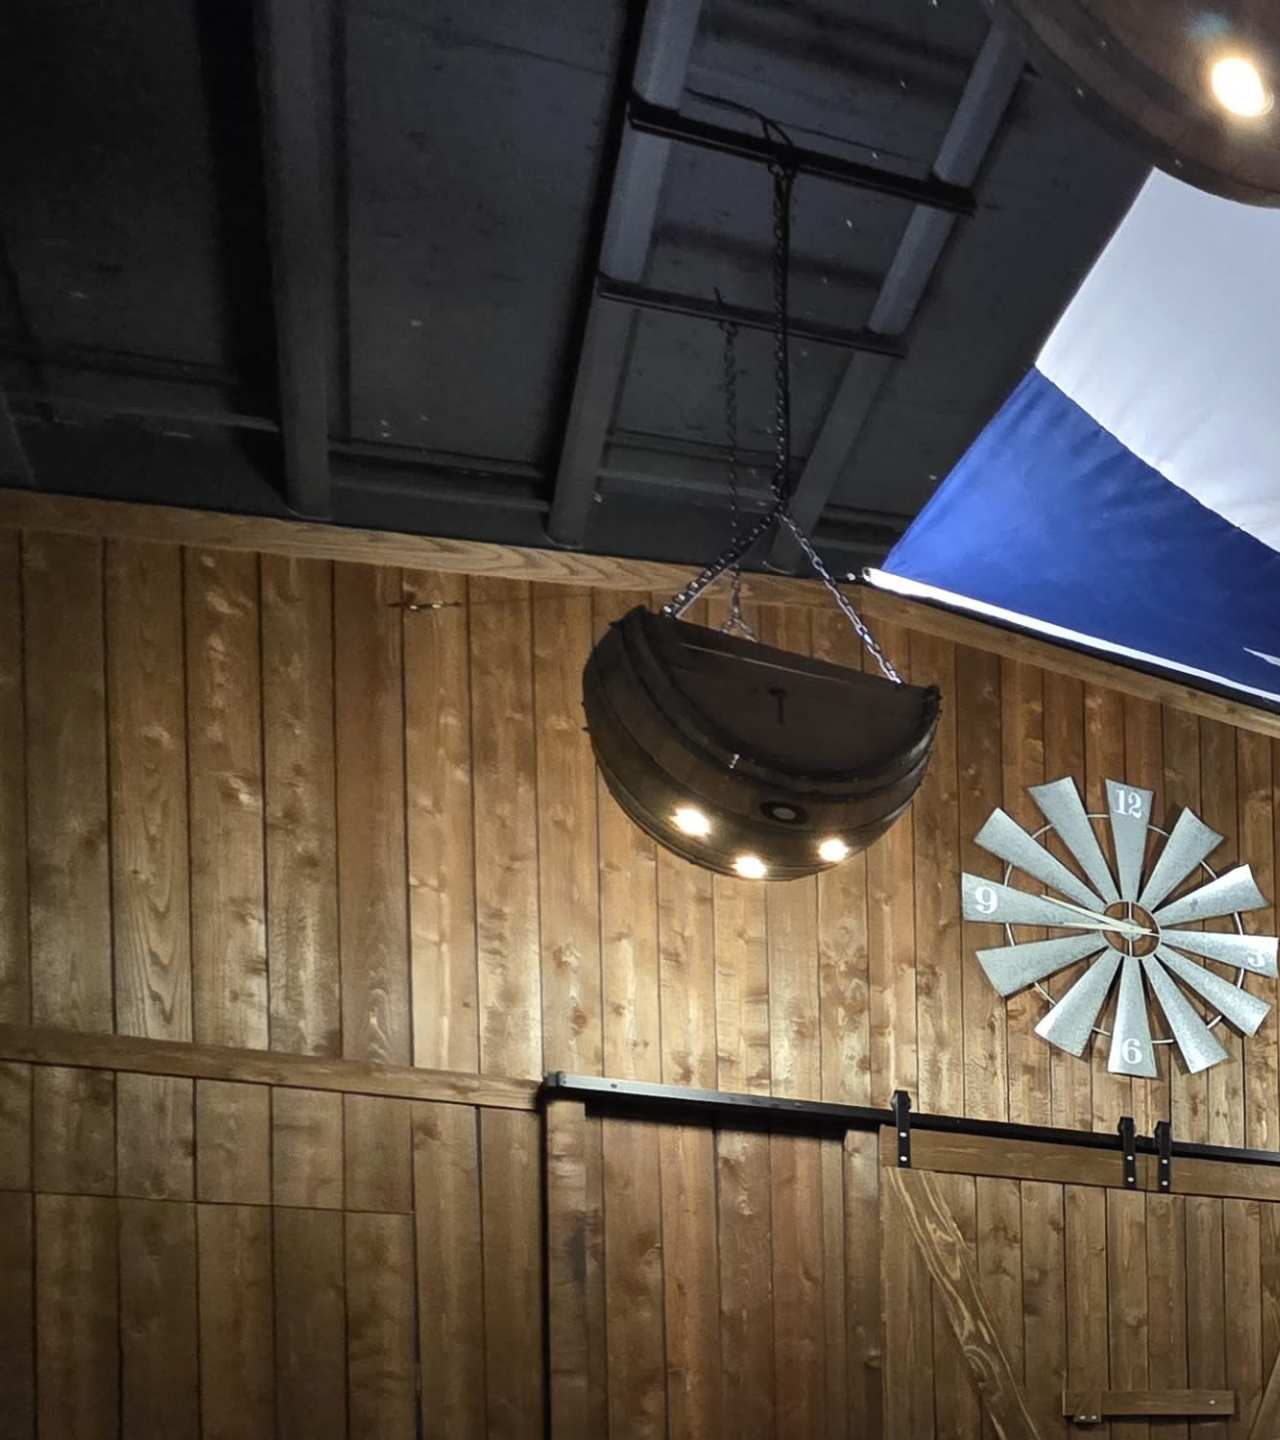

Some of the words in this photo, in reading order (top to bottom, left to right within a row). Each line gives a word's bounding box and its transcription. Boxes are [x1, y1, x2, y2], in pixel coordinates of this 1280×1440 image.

[1113, 788, 1143, 819] 12
[973, 885, 999, 922] 9
[1120, 1037, 1144, 1065] 6
